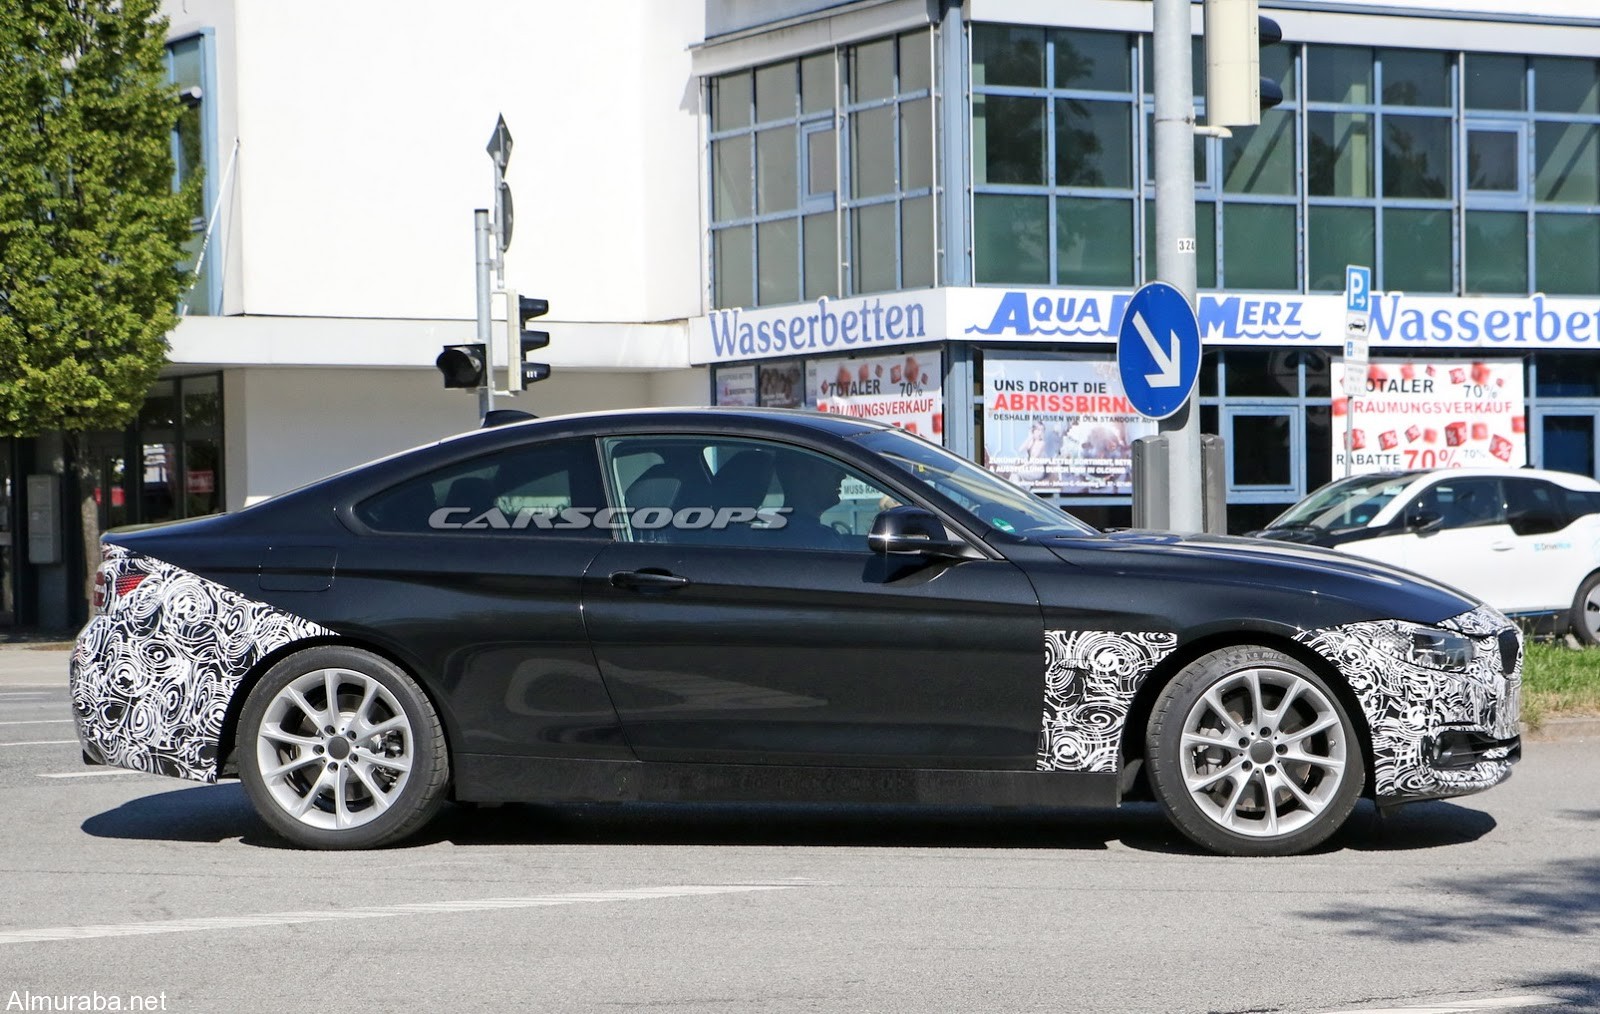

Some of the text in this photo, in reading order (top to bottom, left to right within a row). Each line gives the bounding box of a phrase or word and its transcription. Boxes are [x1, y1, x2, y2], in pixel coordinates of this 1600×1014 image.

[1351, 271, 1364, 307] P
[987, 292, 1101, 335] AQUA
[1199, 296, 1303, 339] MERZ
[709, 298, 926, 357] Wasserbetten
[828, 379, 923, 398] TOTALER 70%
[994, 380, 1107, 394] UNS DROHT DIE
[1365, 378, 1434, 394] OTALER
[1463, 385, 1498, 399] 70%
[1066, 415, 1081, 423] WIR
[1101, 416, 1139, 424] STANDORT
[1403, 449, 1461, 469] 70%
